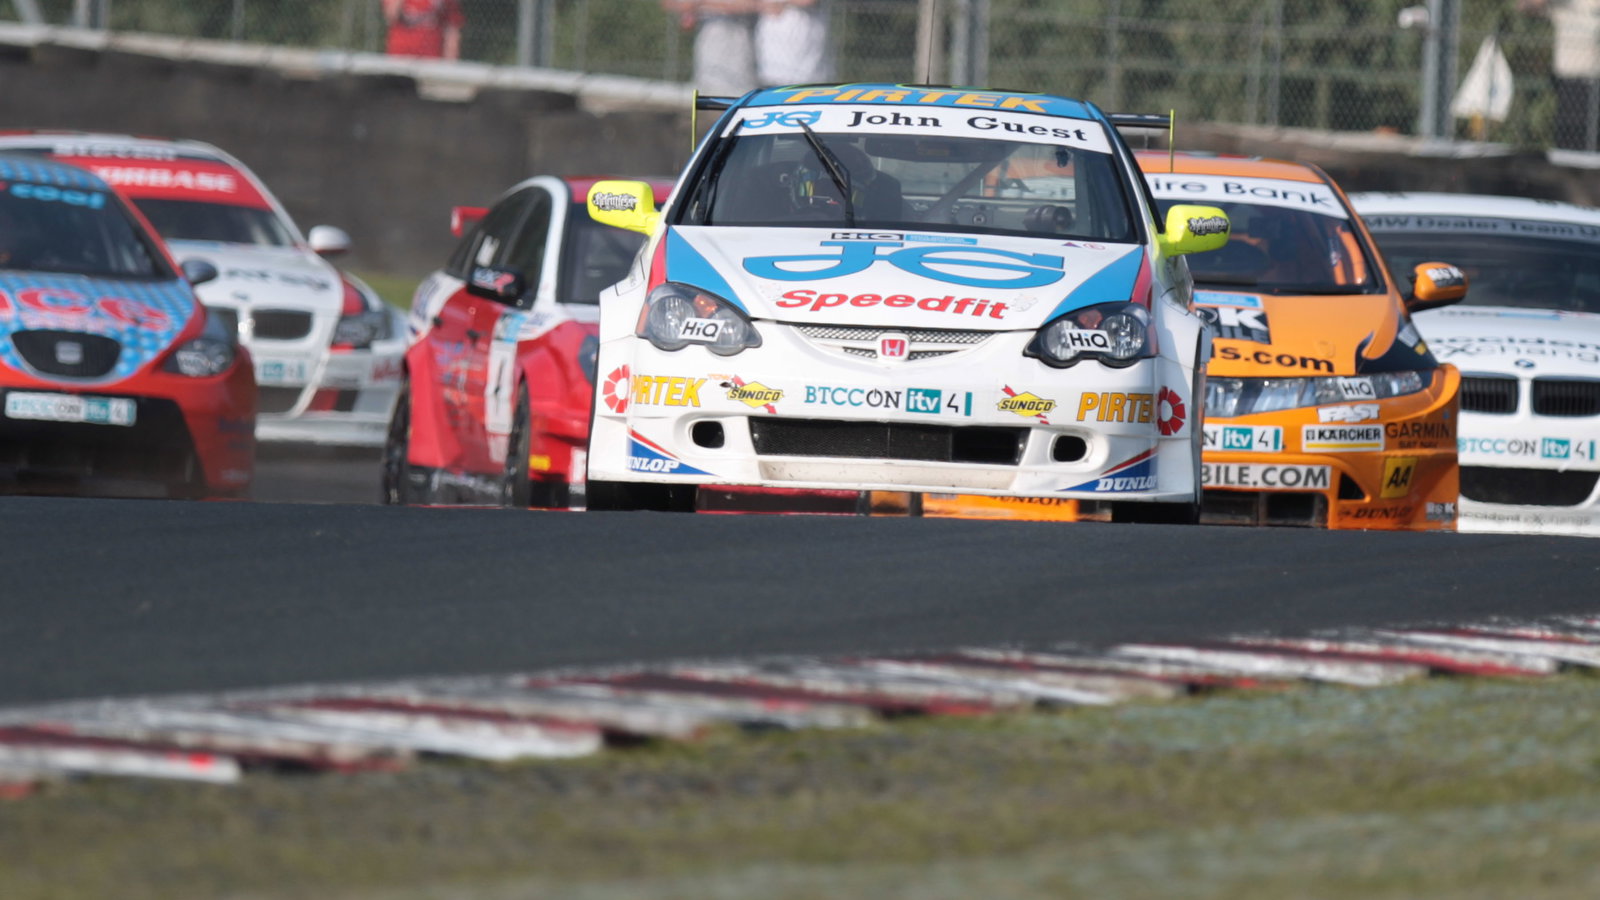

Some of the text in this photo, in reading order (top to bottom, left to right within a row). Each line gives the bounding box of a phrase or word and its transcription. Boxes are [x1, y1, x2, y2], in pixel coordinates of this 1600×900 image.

[784, 88, 1049, 113] PIRTEK
[847, 111, 942, 128] John
[966, 116, 1088, 141] Guest
[91, 165, 237, 192] ORBASE
[1223, 182, 1333, 208] Bank
[776, 289, 1009, 319] Speedfit
[682, 321, 719, 337] HiQ
[1068, 332, 1109, 348] HiQ
[729, 389, 782, 401] SUNOCO
[1342, 381, 1373, 394] HiQ
[907, 388, 940, 412] itv
[1000, 399, 1054, 412] SUNOCO
[1223, 429, 1252, 448] itv
[1385, 422, 1451, 438] GARMIN
[1387, 465, 1412, 488] AA
